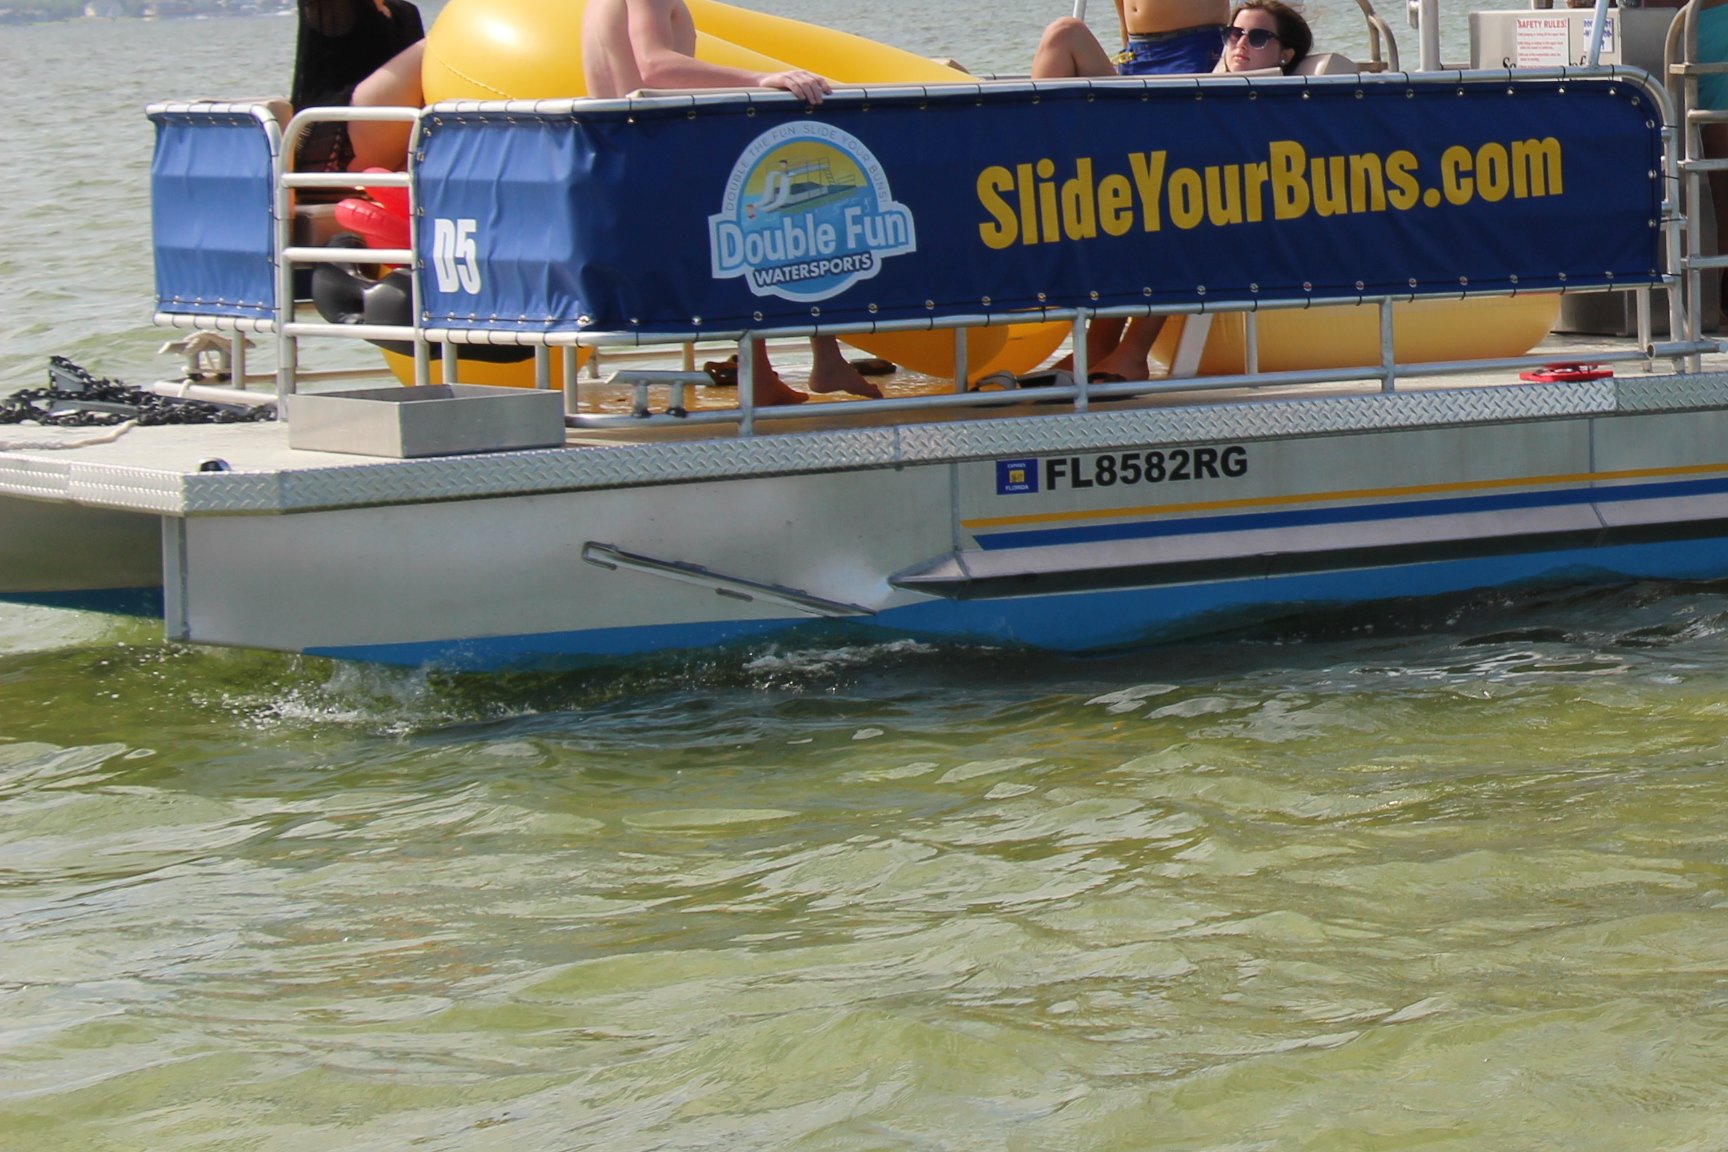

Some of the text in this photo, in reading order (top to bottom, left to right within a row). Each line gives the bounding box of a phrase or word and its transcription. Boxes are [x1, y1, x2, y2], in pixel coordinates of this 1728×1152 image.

[1517, 19, 1567, 29] SAFETY RULES!
[726, 124, 889, 211] DOUBLE THE FUN SLIDE YOUR BUNS!
[976, 137, 1563, 249] SlideYourBuns.com
[433, 218, 482, 295] D5
[717, 206, 907, 268] Double Fun
[754, 253, 872, 287] WATERSPORTS
[1045, 446, 1249, 491] FL8582RG
